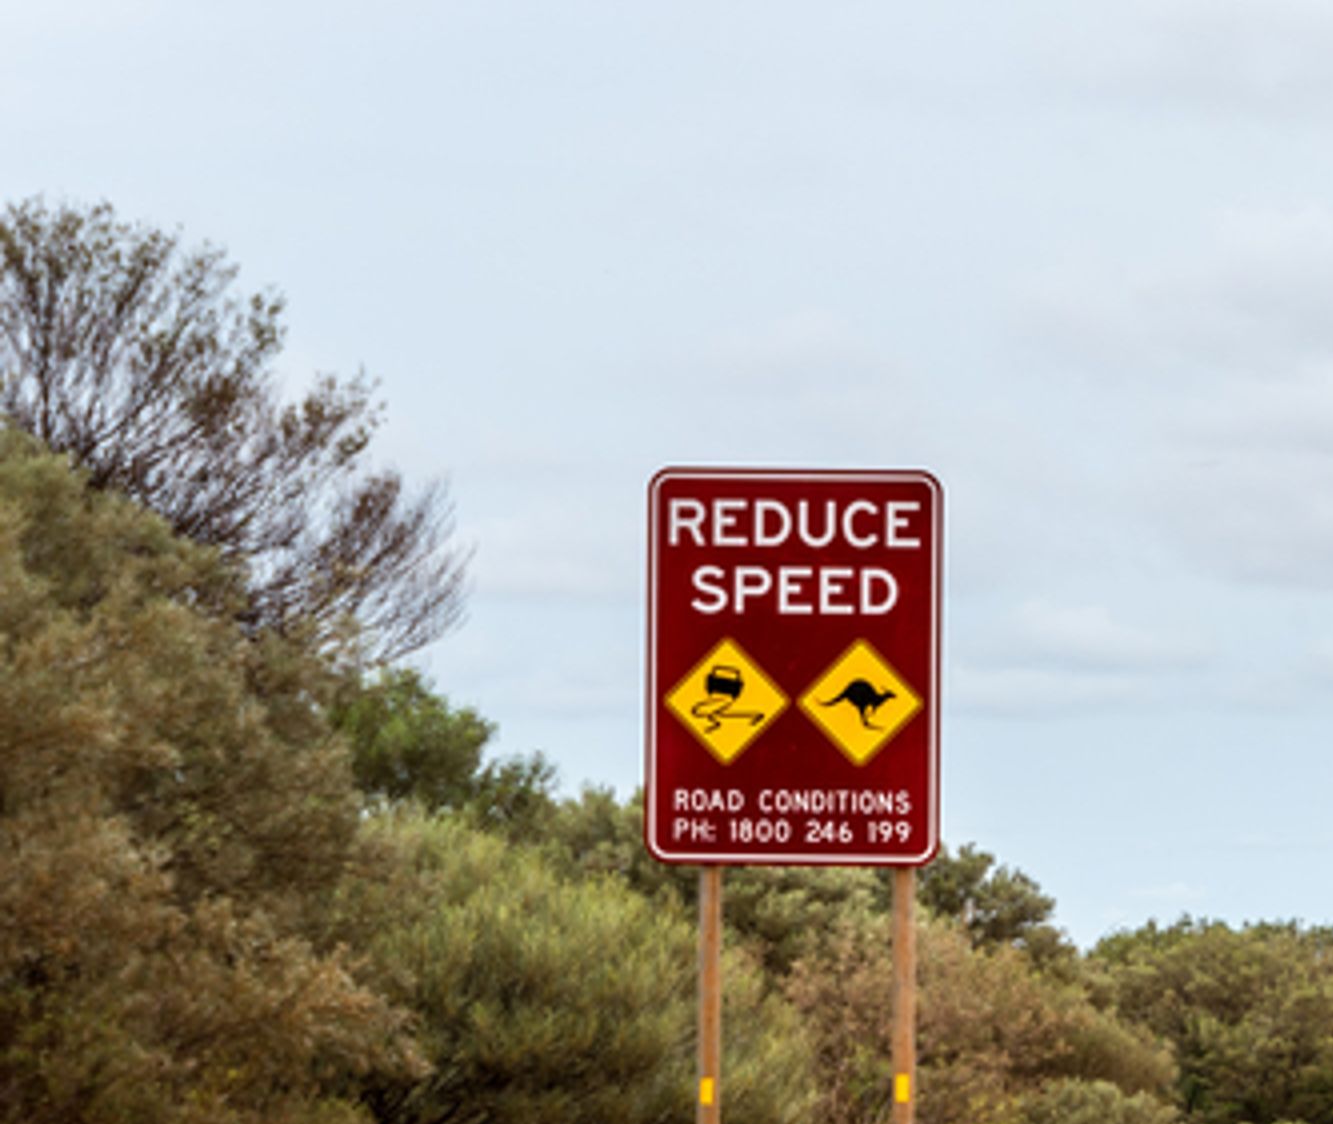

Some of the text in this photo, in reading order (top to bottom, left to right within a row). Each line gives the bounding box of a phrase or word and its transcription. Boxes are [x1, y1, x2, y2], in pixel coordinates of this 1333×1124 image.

[668, 499, 921, 548] REDUCE
[691, 565, 899, 614] SPEED
[673, 789, 911, 815] ROAD CONDITIONS
[672, 818, 911, 844] PH: 1800 246 199
